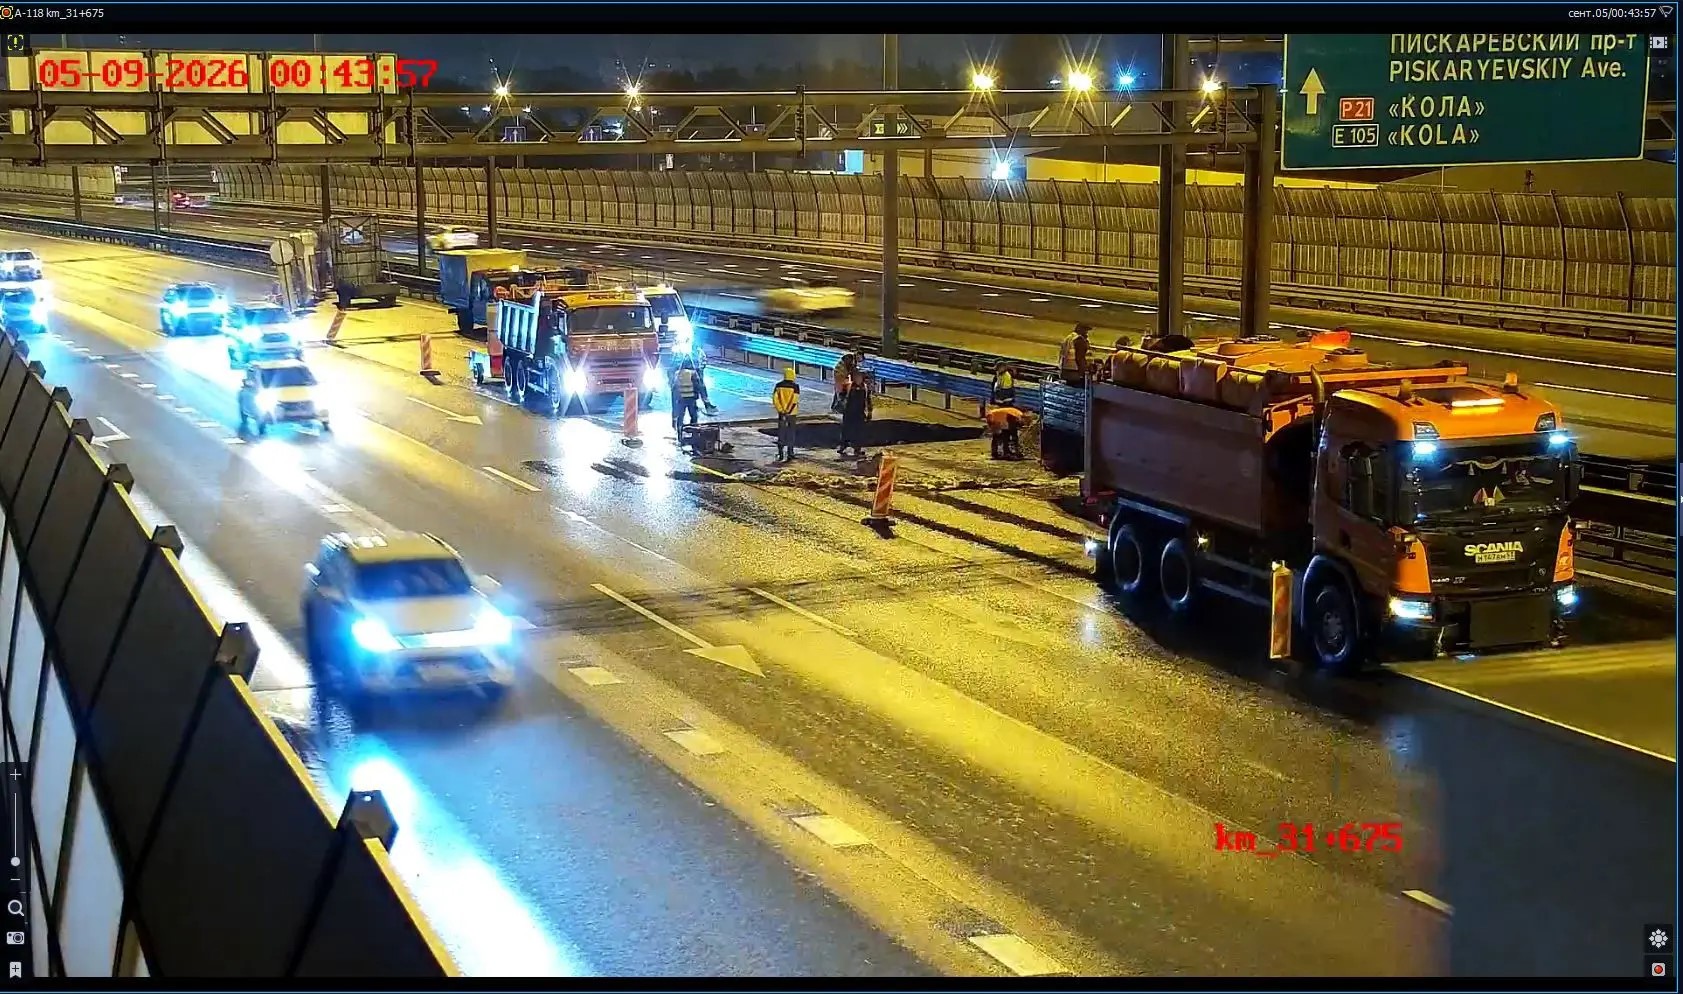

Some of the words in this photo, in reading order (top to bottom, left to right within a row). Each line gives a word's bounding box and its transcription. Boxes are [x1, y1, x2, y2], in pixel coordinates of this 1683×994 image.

[1590, 33, 1637, 56] пр-т
[1389, 57, 1573, 82] PISKARYEVSKIY
[1580, 57, 1627, 79] Ave.
[1388, 94, 1485, 118] «КОЛА»
[1350, 127, 1376, 144] 105
[1387, 123, 1480, 146] «KOLA»
[1464, 541, 1524, 557] SCANIA
